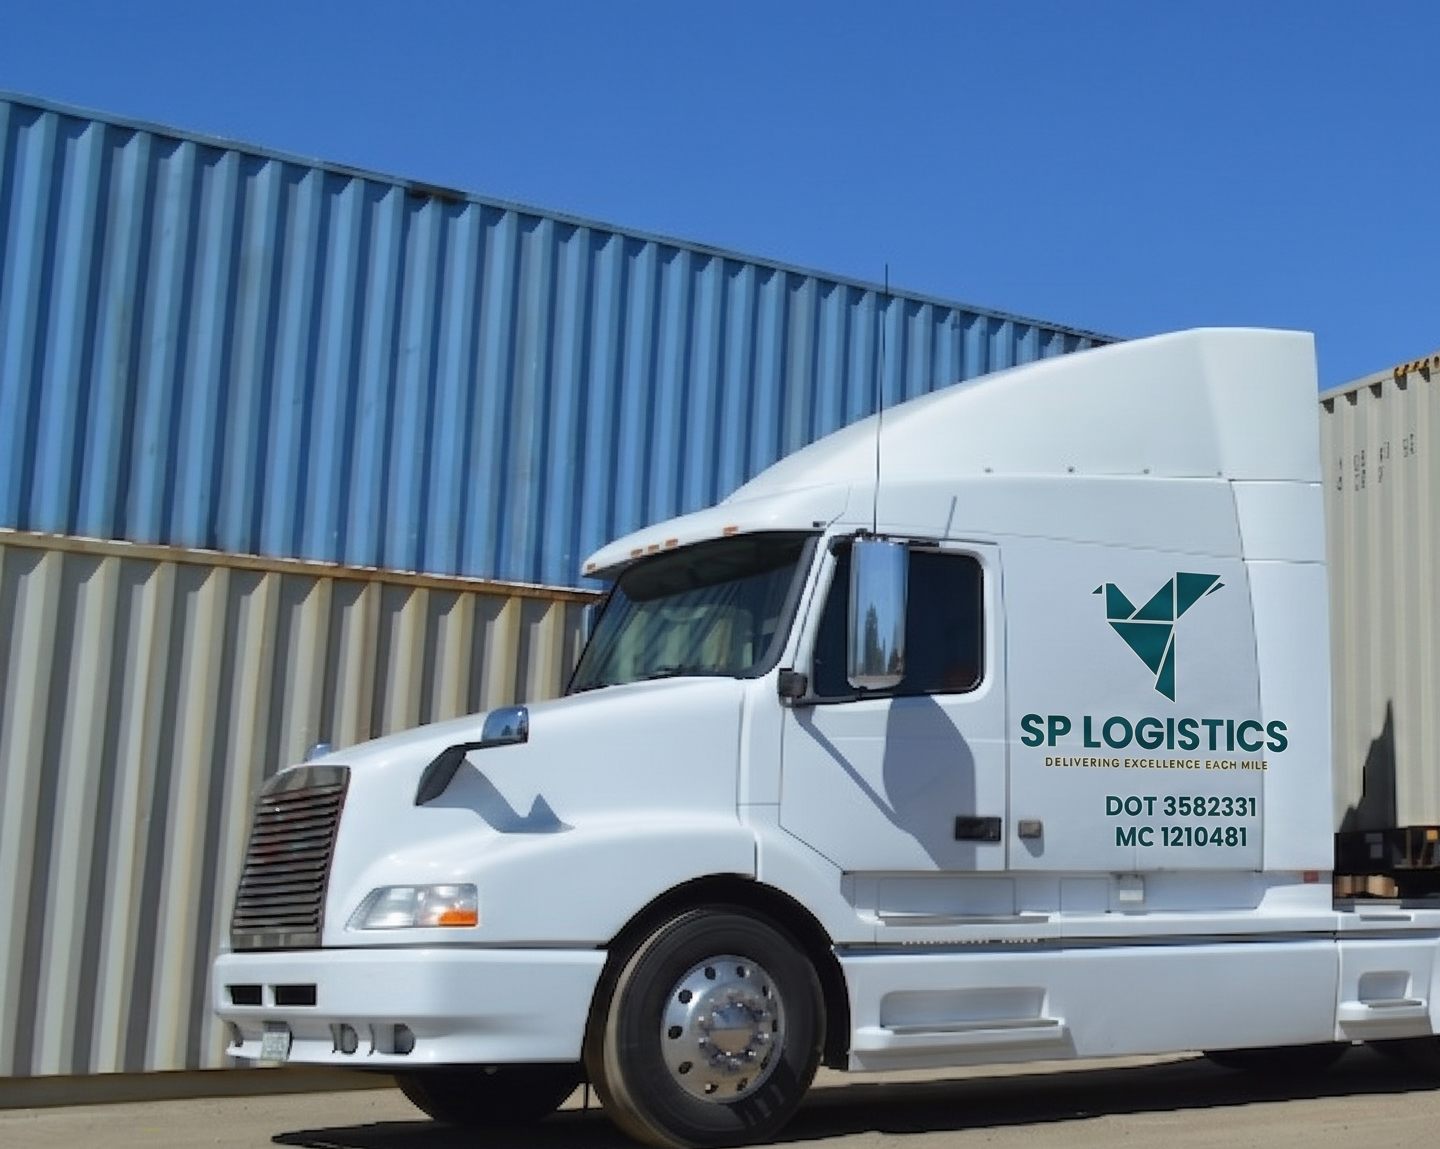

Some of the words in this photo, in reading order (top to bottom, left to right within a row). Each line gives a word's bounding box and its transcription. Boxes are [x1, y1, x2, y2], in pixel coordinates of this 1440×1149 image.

[1020, 713, 1072, 748] SP
[1083, 715, 1289, 753] LOGISTICS
[1045, 756, 1120, 768] DELIVERING
[1124, 758, 1201, 770] EXCELLENCE
[1205, 760, 1237, 770] EACH
[1241, 760, 1268, 770] MILE
[1105, 795, 1158, 817] DOT
[1163, 795, 1256, 817] 3582331
[1115, 826, 1155, 847] MC
[1160, 825, 1247, 847] 1210481
